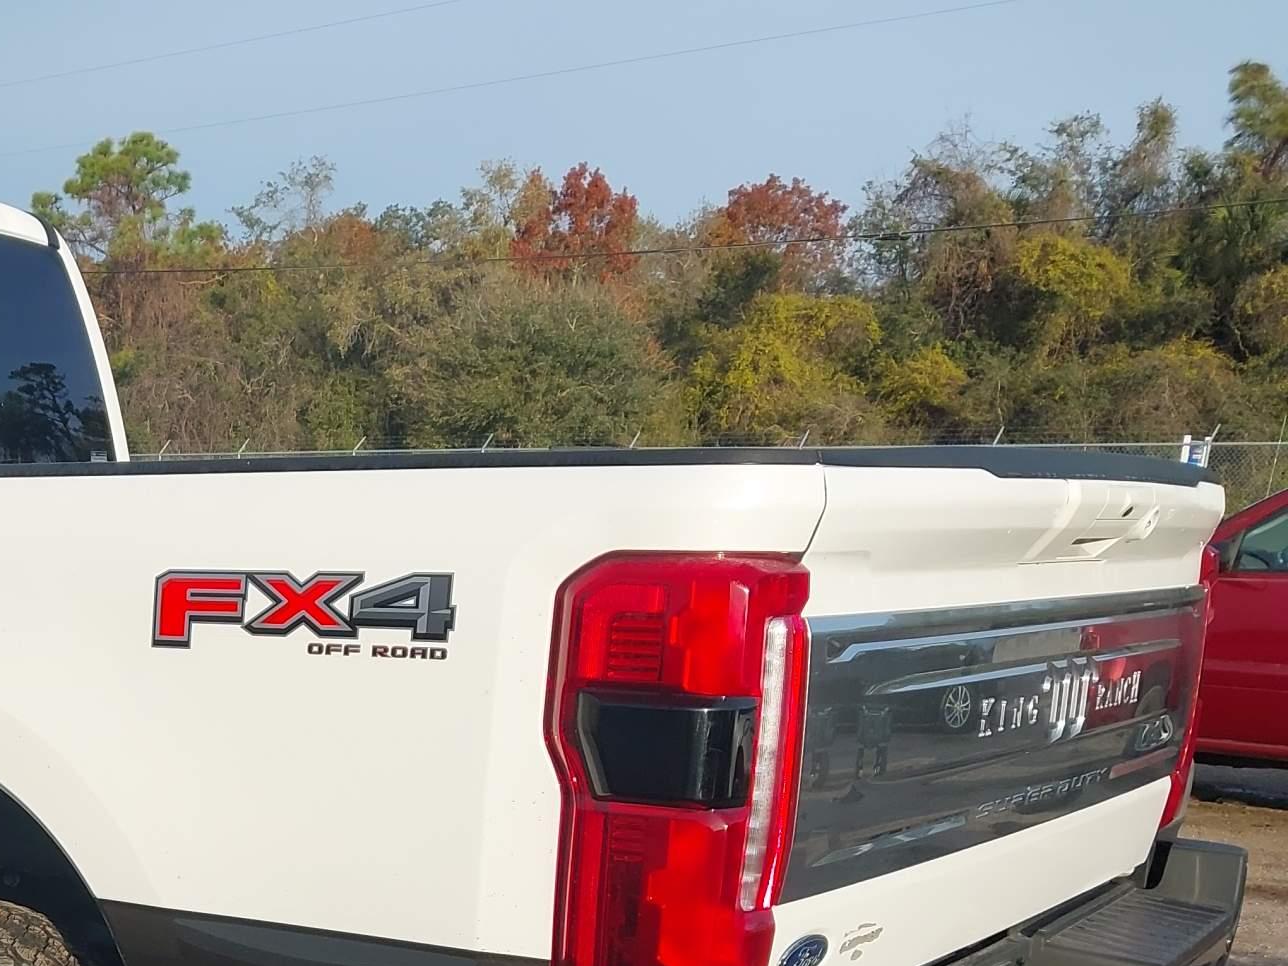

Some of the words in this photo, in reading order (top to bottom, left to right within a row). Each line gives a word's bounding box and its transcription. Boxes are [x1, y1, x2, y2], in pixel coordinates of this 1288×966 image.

[152, 569, 457, 649] FX4
[307, 642, 361, 656] OFF
[371, 645, 449, 661] ROAD
[978, 695, 1039, 737] KING
[1095, 670, 1141, 710] RANCH
